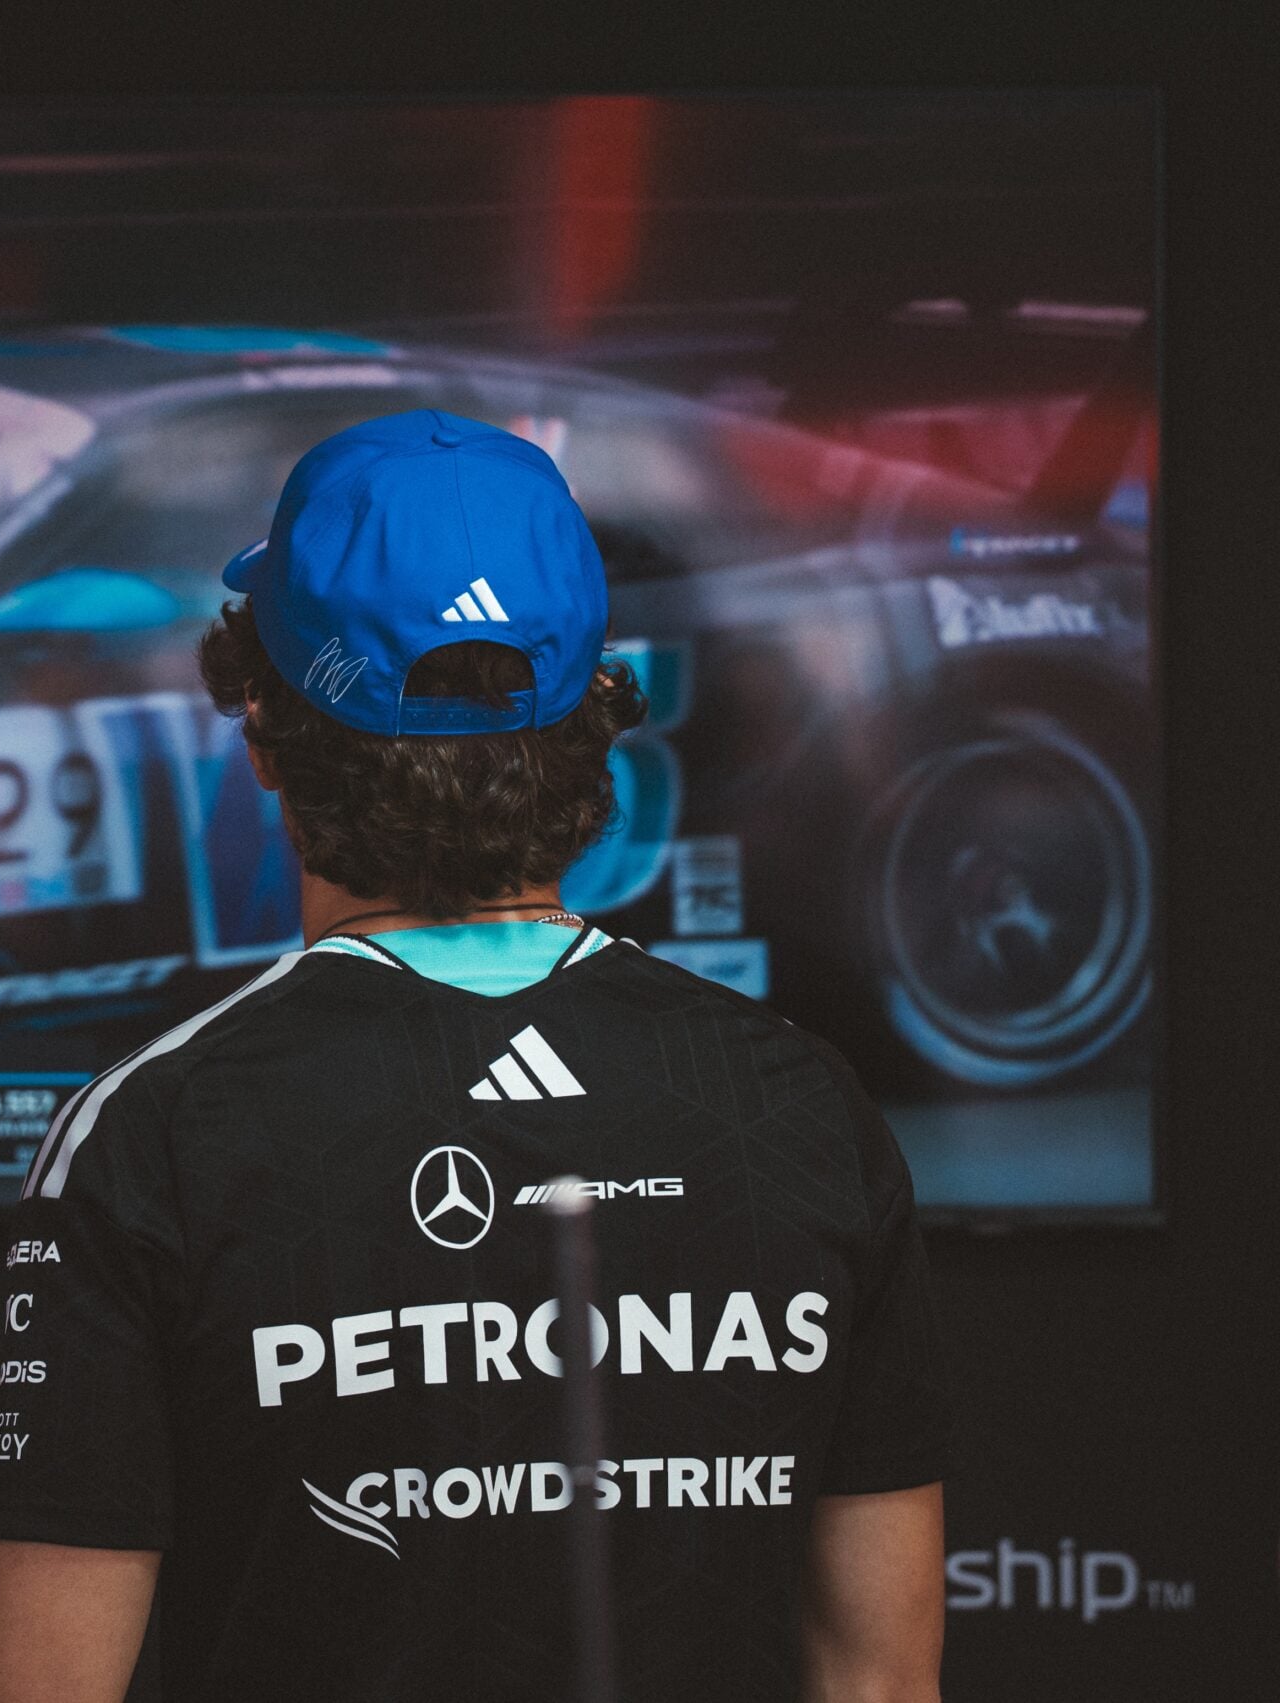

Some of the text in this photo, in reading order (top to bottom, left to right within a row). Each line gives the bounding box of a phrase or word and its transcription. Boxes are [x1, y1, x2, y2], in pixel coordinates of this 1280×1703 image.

[558, 1176, 684, 1201] AMG
[252, 1291, 829, 1408] PETRONAS
[345, 1455, 795, 1519] CROWDSTRIKE
